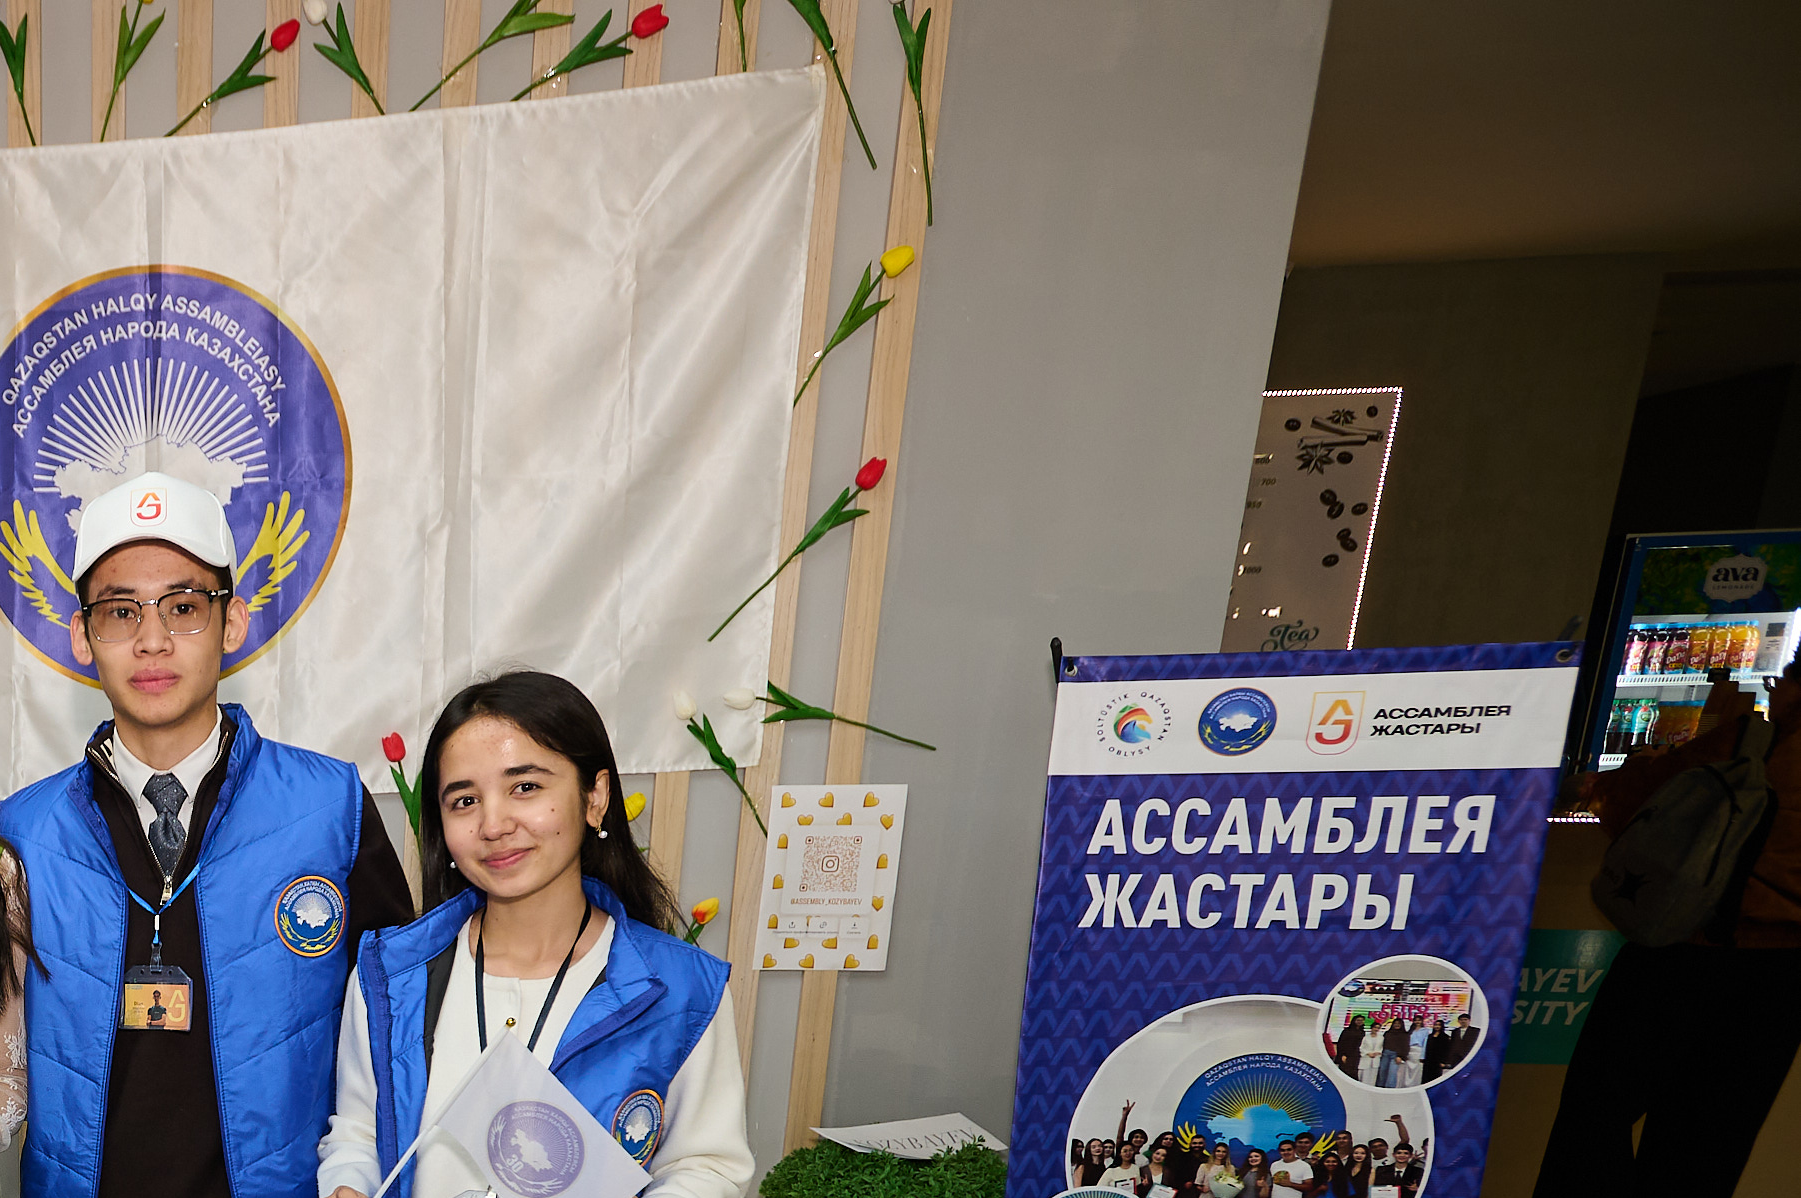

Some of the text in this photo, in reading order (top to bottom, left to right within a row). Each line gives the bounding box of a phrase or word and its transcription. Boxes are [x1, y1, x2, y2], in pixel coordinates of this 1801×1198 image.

[1, 293, 287, 407] QAZAQSTAN HALQY ASSAMBLEIASY
[11, 320, 281, 439] АССАМБЛЕЯ НАРОДА КАЗАХСТАНА
[1712, 567, 1759, 582] ava
[1261, 619, 1319, 651] Tea
[1373, 704, 1512, 719] АССАМБЛЕЯ
[1370, 722, 1481, 737] ЖАСТАРЫ
[1086, 794, 1497, 856] АССАМБЛЕЯ
[1077, 872, 1415, 931] ЖАСТАРЫ
[506, 1154, 524, 1173] 30
